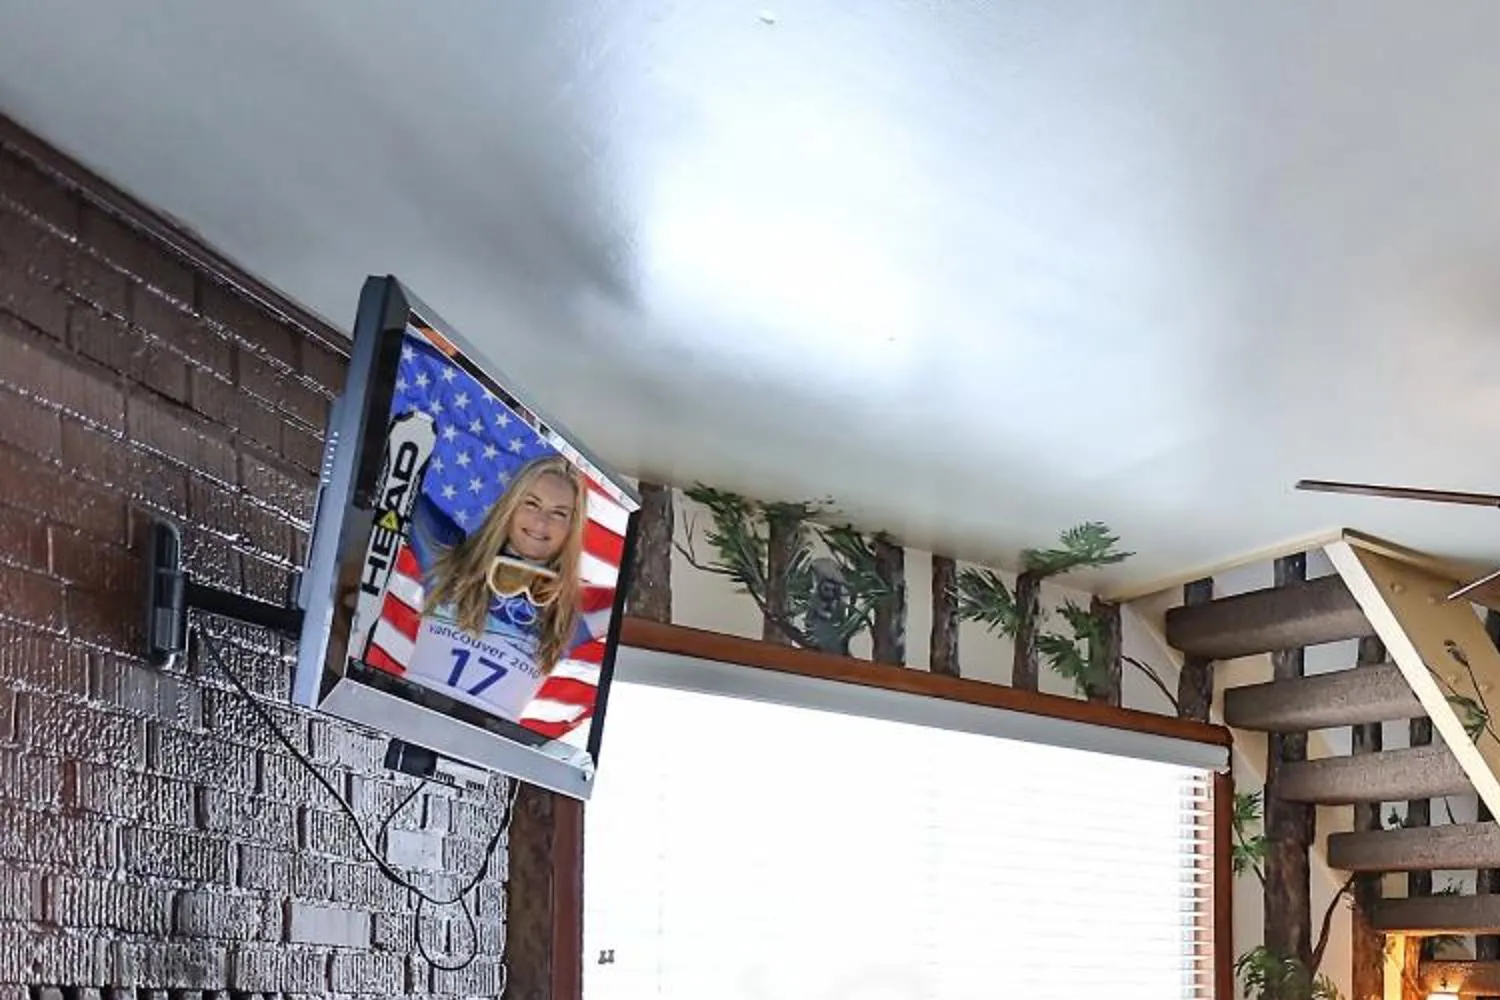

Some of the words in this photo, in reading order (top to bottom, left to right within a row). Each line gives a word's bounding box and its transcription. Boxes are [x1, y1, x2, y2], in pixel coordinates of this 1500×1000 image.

[361, 441, 419, 597] HEAD
[428, 623, 507, 660] vancouver
[447, 648, 509, 697] 17
